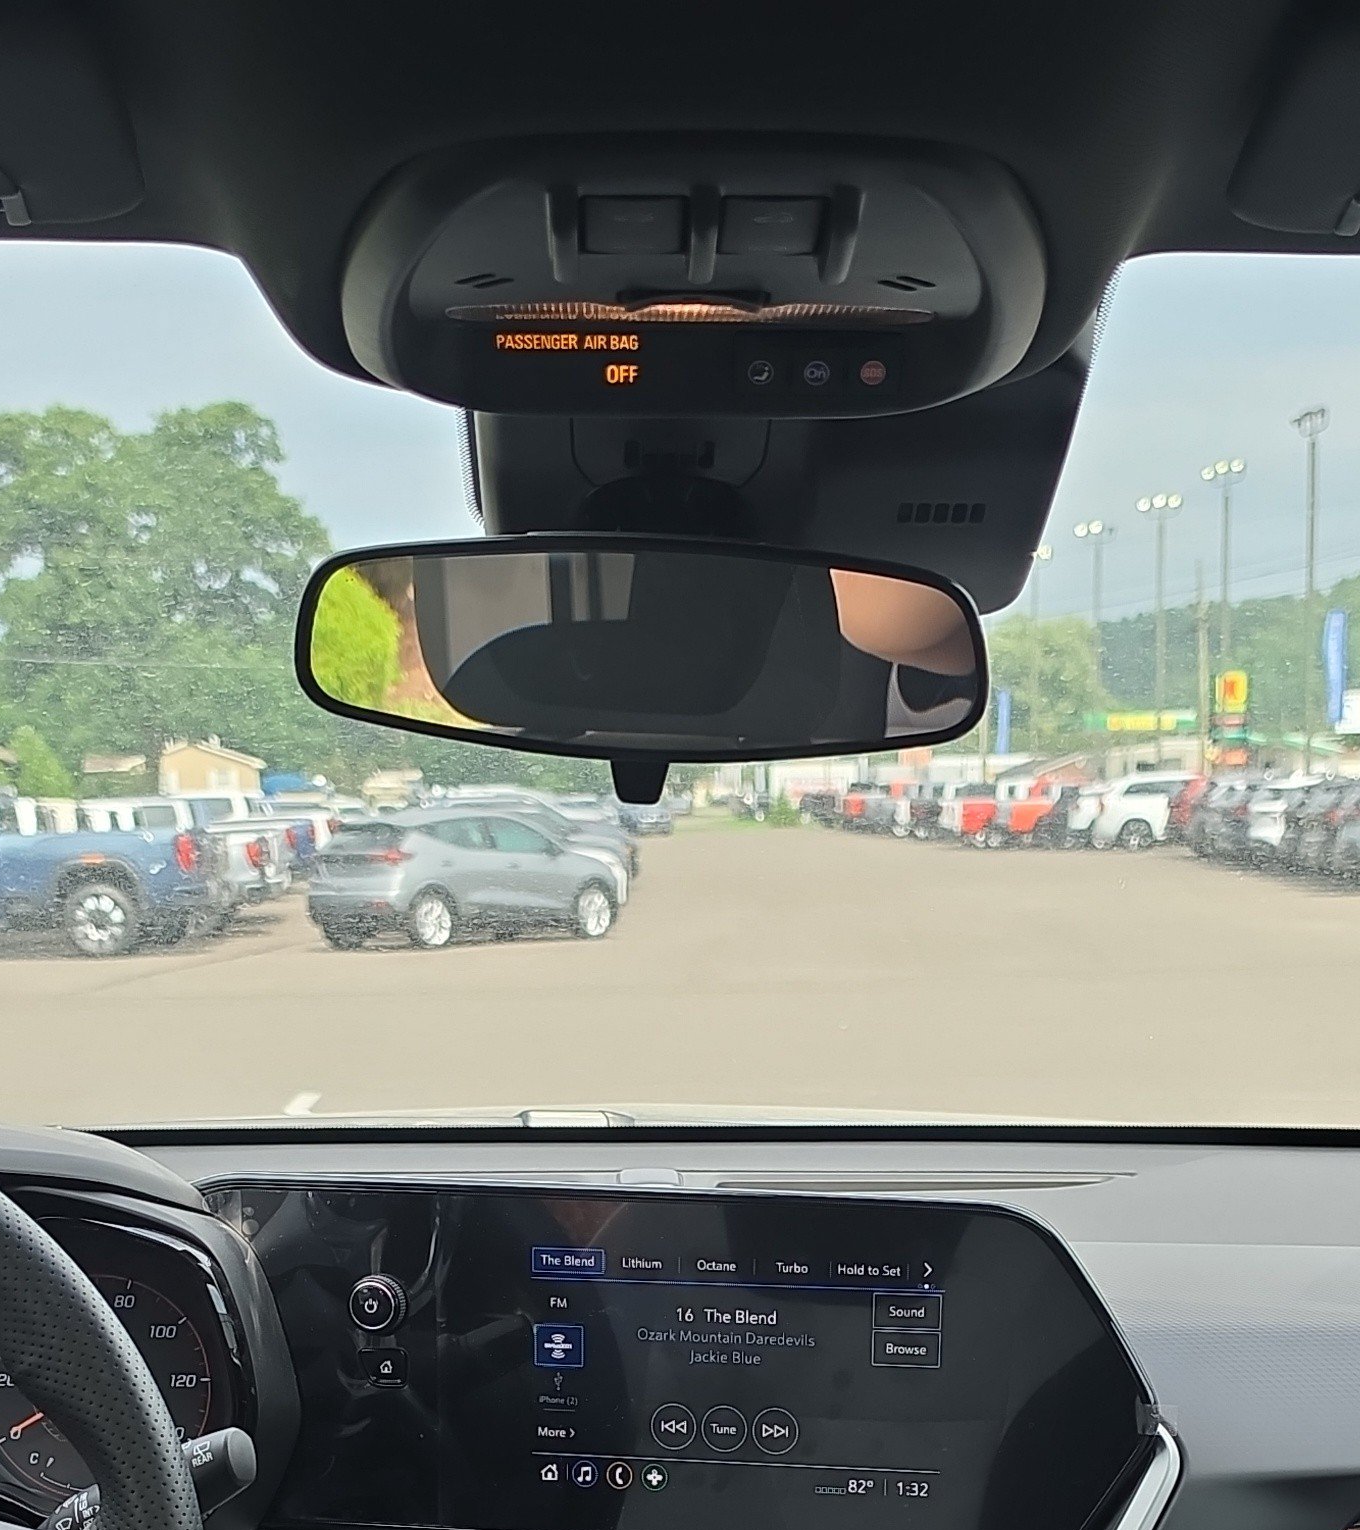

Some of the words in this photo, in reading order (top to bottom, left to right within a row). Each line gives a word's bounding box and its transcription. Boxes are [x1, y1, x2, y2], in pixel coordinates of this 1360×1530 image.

[496, 334, 578, 350] PASSENGER
[583, 334, 607, 350] AIR
[610, 334, 639, 350] BAG
[606, 364, 639, 384] OFF
[540, 1254, 561, 1267] The
[563, 1254, 595, 1268] Blend
[622, 1256, 662, 1270] Lithium
[697, 1259, 737, 1272] Octane
[776, 1262, 809, 1275] Turbo
[838, 1263, 864, 1276] Hold
[867, 1265, 877, 1276] to
[879, 1264, 901, 1277] Set
[114, 1295, 135, 1308] 80
[550, 1297, 568, 1309] FM
[676, 1308, 694, 1322] 16
[704, 1308, 732, 1323] The
[735, 1310, 777, 1325] Blend
[889, 1305, 925, 1318] Sound
[150, 1325, 176, 1338] 100
[637, 1328, 676, 1342] Ozark
[679, 1330, 741, 1344] Mountain
[745, 1332, 815, 1347] Daredevils
[886, 1343, 927, 1356] Browse
[689, 1349, 728, 1365] Jackie
[732, 1351, 761, 1365] Blue
[170, 1374, 196, 1388] 120
[537, 1426, 566, 1437] More
[710, 1423, 737, 1435] Tune
[30, 1453, 38, 1464] C
[191, 1451, 213, 1468] REAR
[896, 1482, 929, 1498] 1:32
